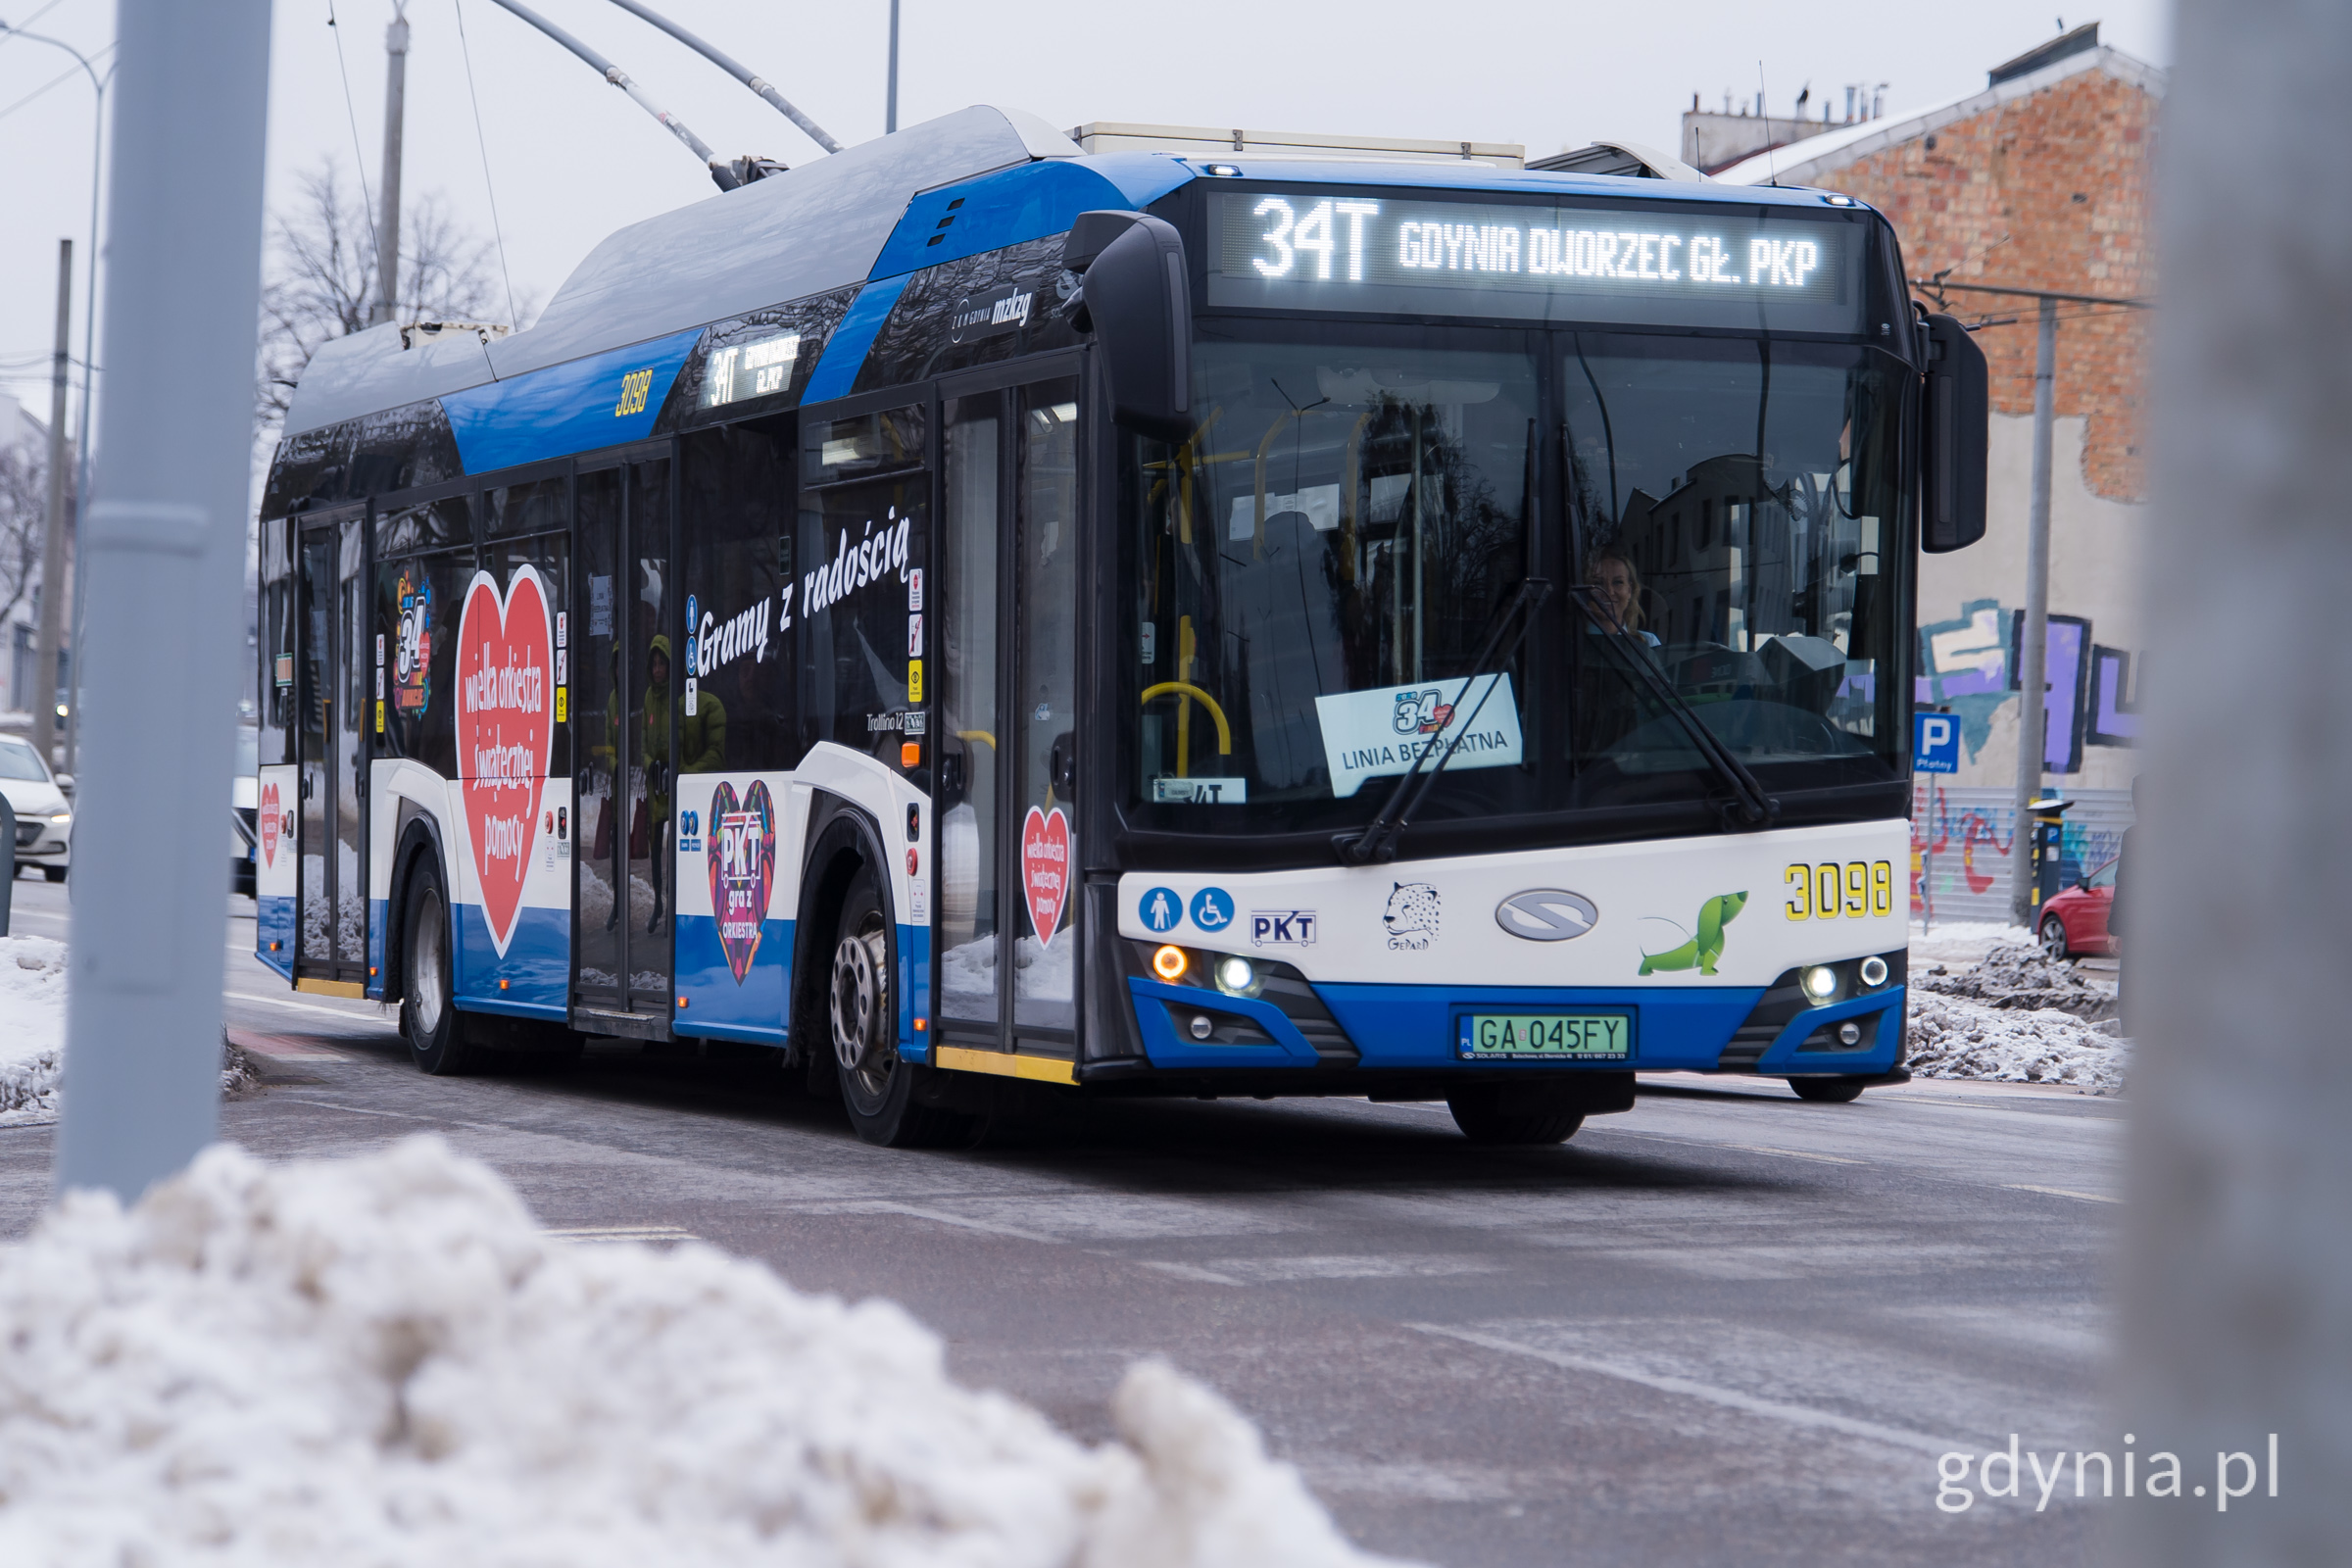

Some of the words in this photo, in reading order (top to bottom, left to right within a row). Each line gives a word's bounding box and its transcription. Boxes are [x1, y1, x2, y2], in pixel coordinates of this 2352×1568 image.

[1251, 198, 1380, 280] 34T
[1399, 221, 1520, 272] GDYNIA
[1528, 227, 1682, 280] DWORZEC
[1689, 235, 1741, 283] GŁ.
[1750, 238, 1820, 286] PKP
[991, 287, 1032, 327] mzkzg
[614, 368, 654, 417] 3098
[710, 347, 739, 406] 34T
[697, 596, 770, 678] Gramy
[779, 582, 794, 632] z
[803, 505, 910, 619] radością
[398, 596, 426, 683] 34
[465, 641, 497, 713] wielka
[499, 645, 542, 714] orkiestra
[866, 712, 895, 732] Trollino
[896, 711, 904, 730] 12
[1394, 689, 1442, 736] 34
[1922, 717, 1951, 756] P
[472, 723, 534, 819] świątecznej
[1342, 746, 1396, 770] LINIA
[484, 813, 524, 883] pomocy
[723, 821, 760, 875] PKT
[728, 890, 745, 915] gra
[746, 890, 753, 907] z
[1785, 860, 1891, 921] 3098
[1254, 912, 1313, 941] PKT
[1461, 1038, 1472, 1047] PL
[1481, 1019, 1517, 1050] GA
[1530, 1019, 1620, 1050] 045FY
